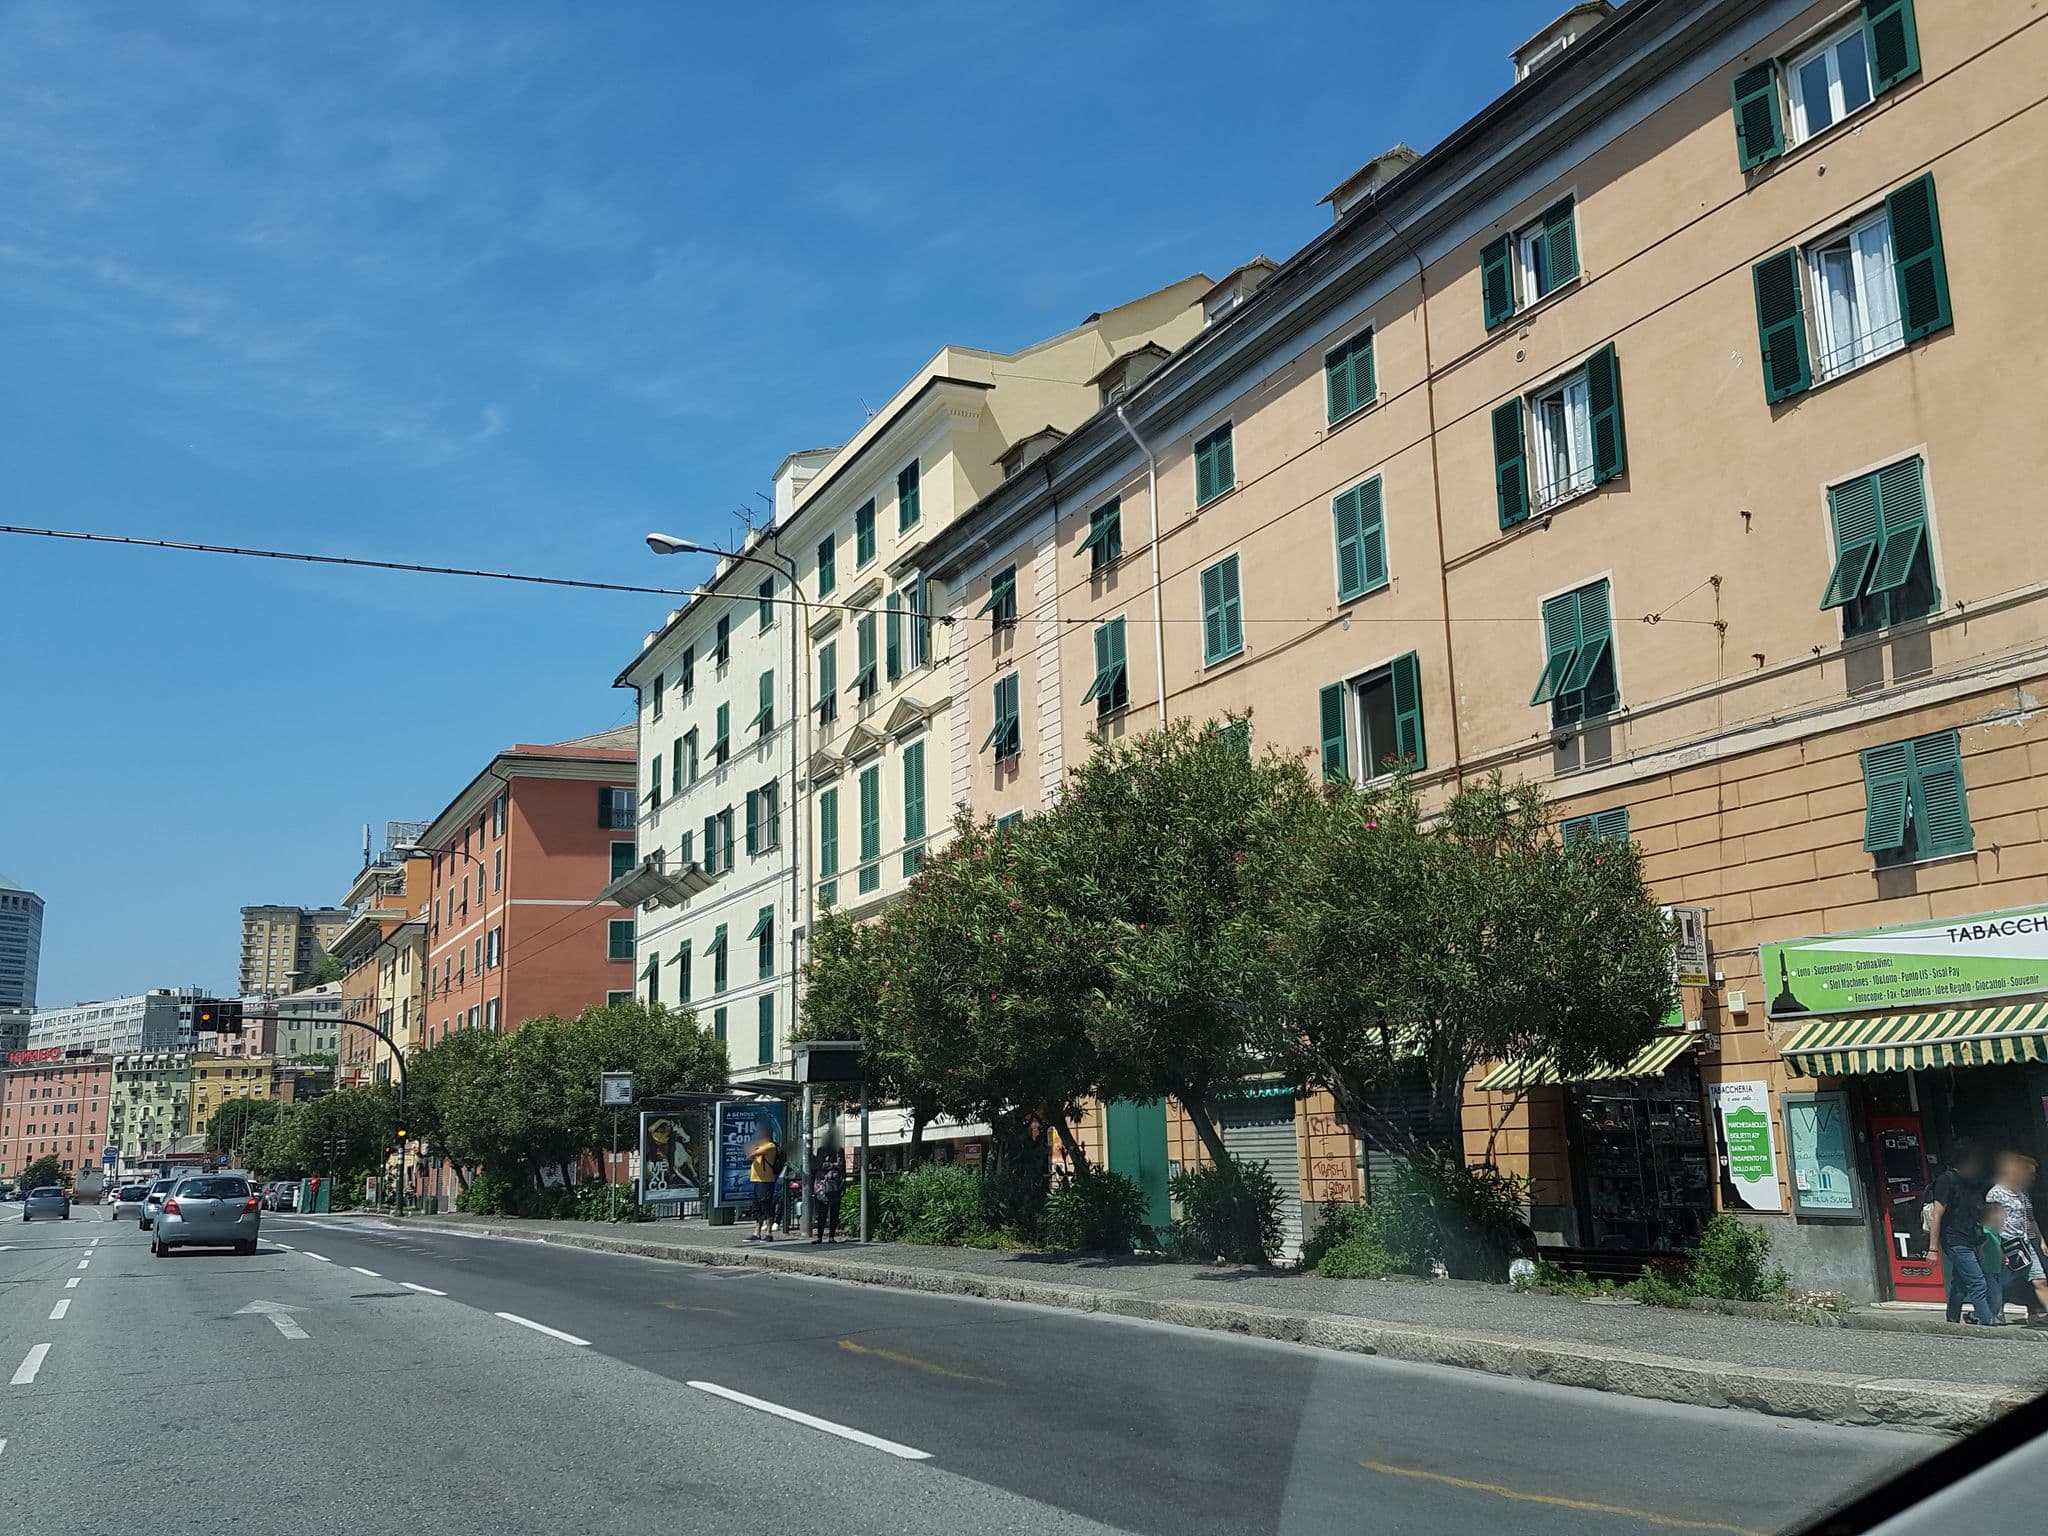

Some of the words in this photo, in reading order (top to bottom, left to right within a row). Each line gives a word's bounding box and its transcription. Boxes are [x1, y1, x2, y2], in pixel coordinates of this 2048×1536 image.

[1947, 916, 2048, 943] TABACCH
[1797, 967, 1811, 977] Lotto
[1813, 962, 1853, 976] Superenalotto
[1829, 979, 1841, 990] Slot
[1841, 976, 1869, 989] Machines
[1901, 971, 1919, 982] Punto
[1932, 967, 1948, 979] Sisal
[1948, 966, 1960, 978] Pay
[1855, 992, 1883, 1003] Fotocopie
[1886, 989, 1897, 1000] Fax
[1900, 986, 1931, 998] Cartoleria
[1934, 983, 1949, 995] Idee
[1949, 981, 1971, 994] Regalo
[1975, 978, 2006, 990] Giocattoli
[2010, 975, 2039, 987] Souvenir
[1710, 1085, 1753, 1096] TABACCHERIA
